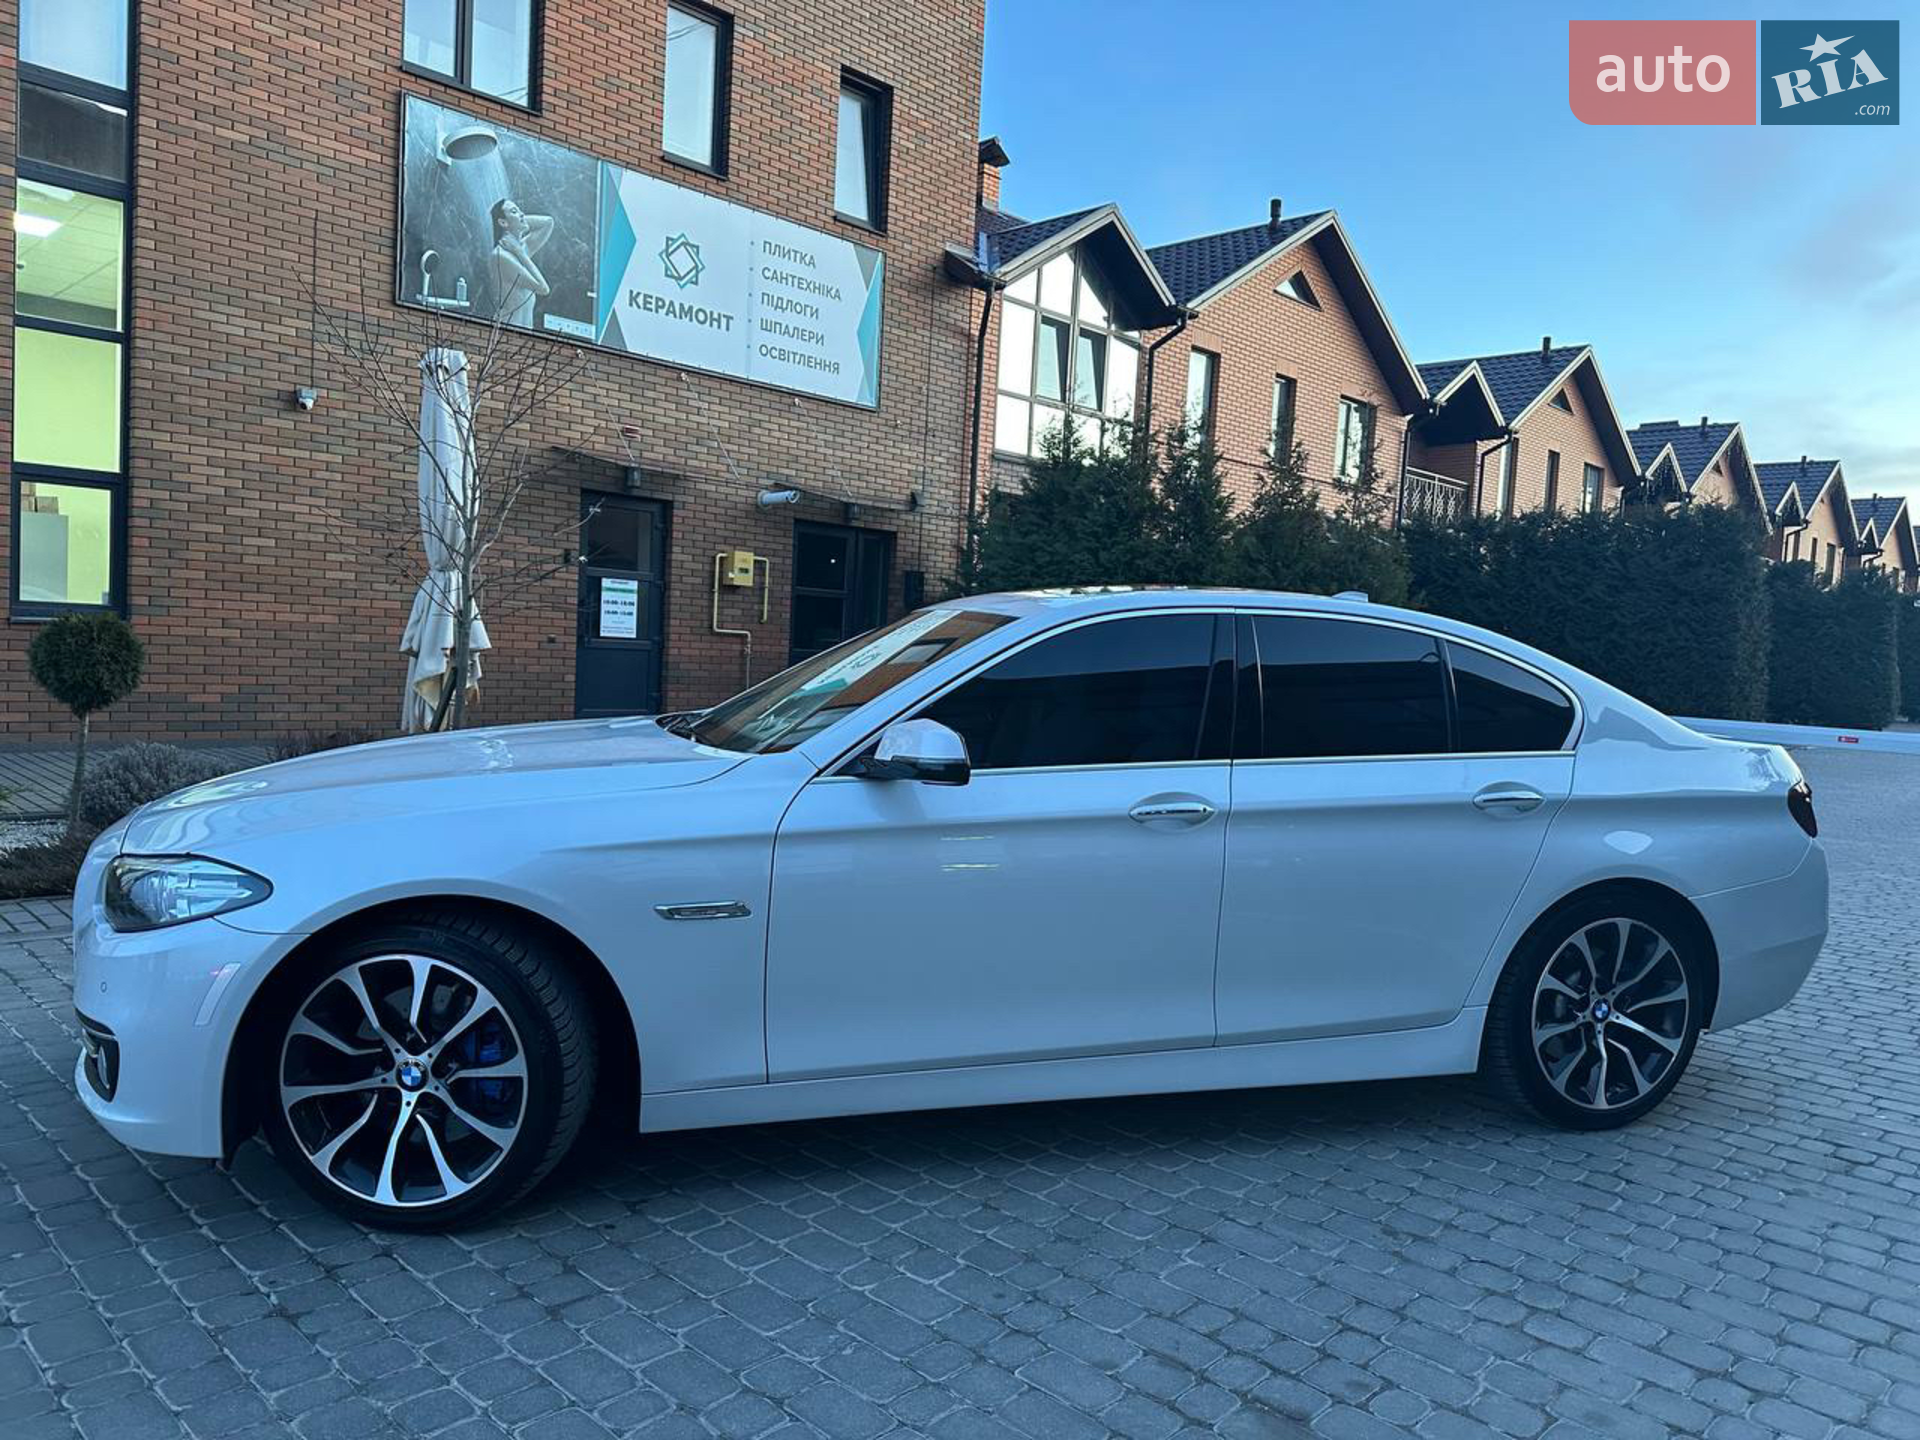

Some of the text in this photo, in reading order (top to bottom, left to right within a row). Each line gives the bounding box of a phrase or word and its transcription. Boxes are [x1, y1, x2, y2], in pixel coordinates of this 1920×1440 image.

[763, 240, 816, 269] ПЛИТКА
[761, 266, 841, 301] САНТЕХНІКА
[628, 289, 734, 332] КЕРАМОНТ
[761, 292, 819, 320] ПІДЛОГИ
[760, 317, 824, 346] ШПАЛЕРИ
[759, 344, 840, 375] ОСВІТЛЕННЯ
